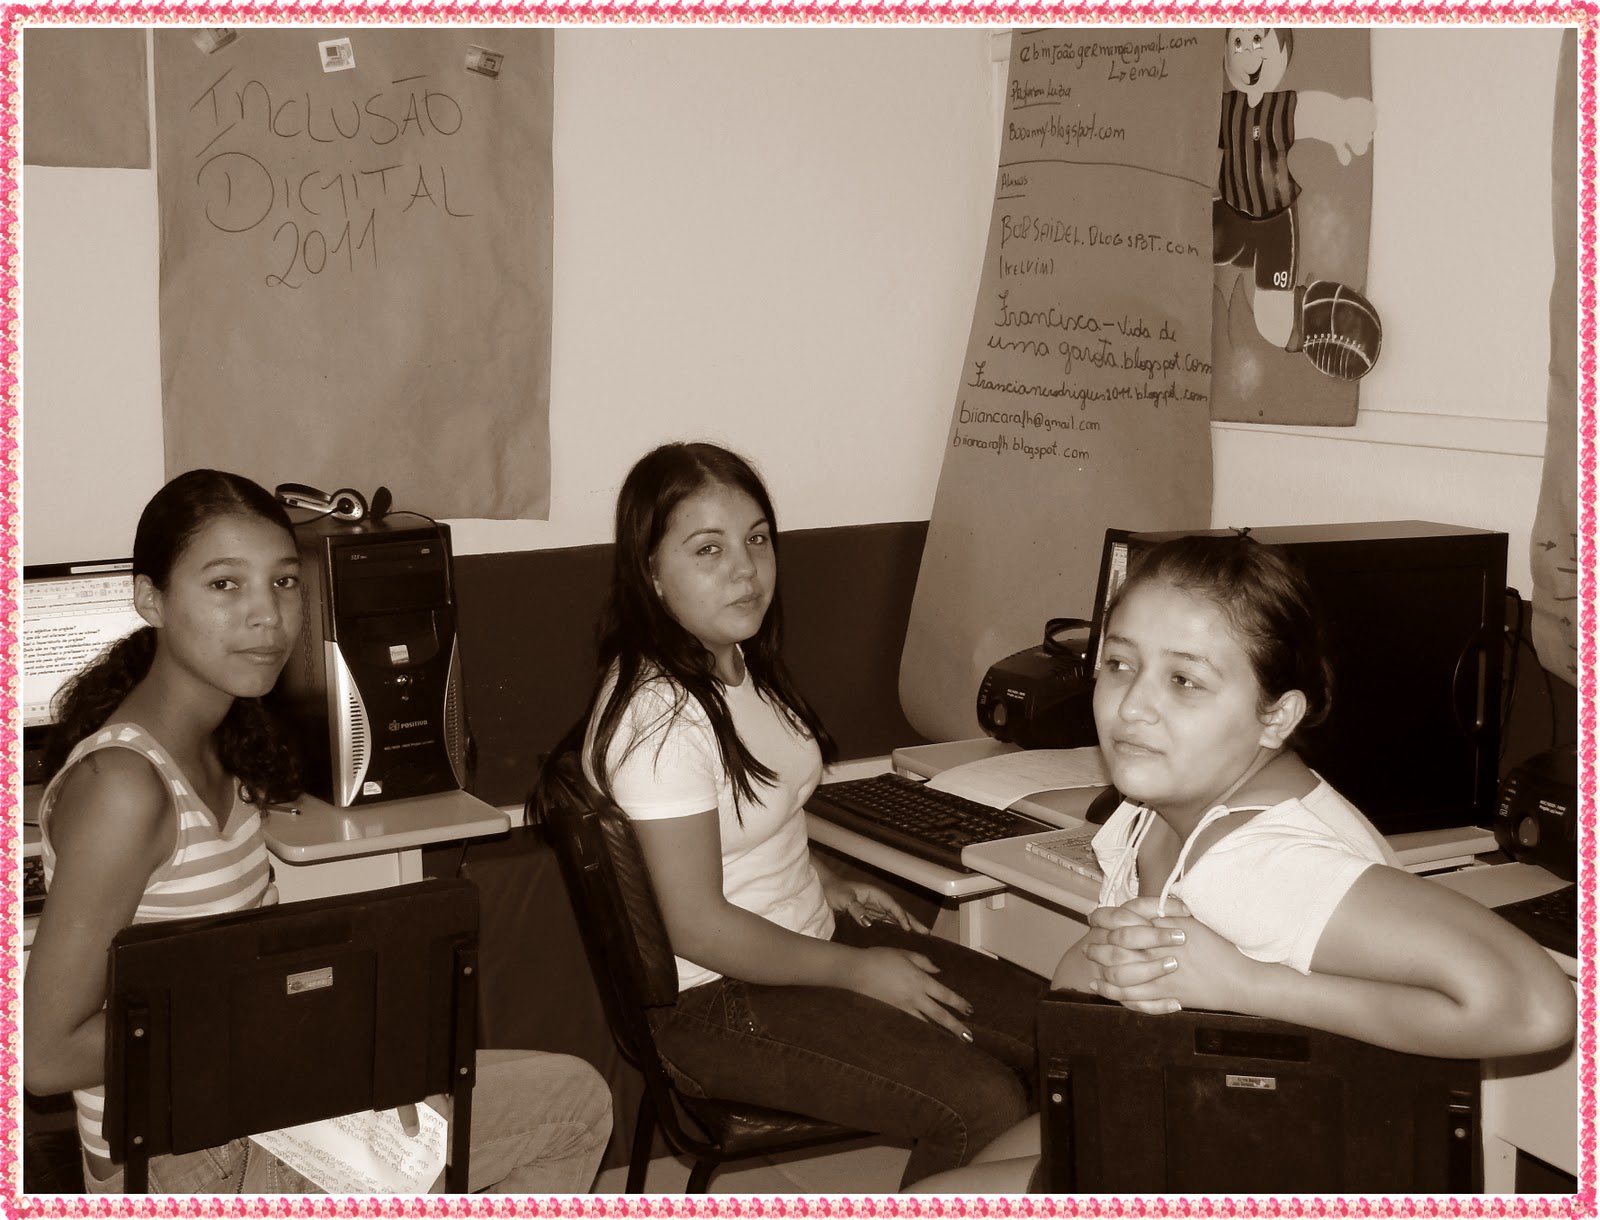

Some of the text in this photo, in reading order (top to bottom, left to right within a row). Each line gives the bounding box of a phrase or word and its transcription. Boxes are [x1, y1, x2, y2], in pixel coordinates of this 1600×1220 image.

[196, 122, 474, 233] DIGITAL
[265, 207, 377, 289] 2011
[1273, 271, 1288, 288] 09
[987, 335, 1050, 356] uma
[400, 719, 428, 729] POSITIVO
